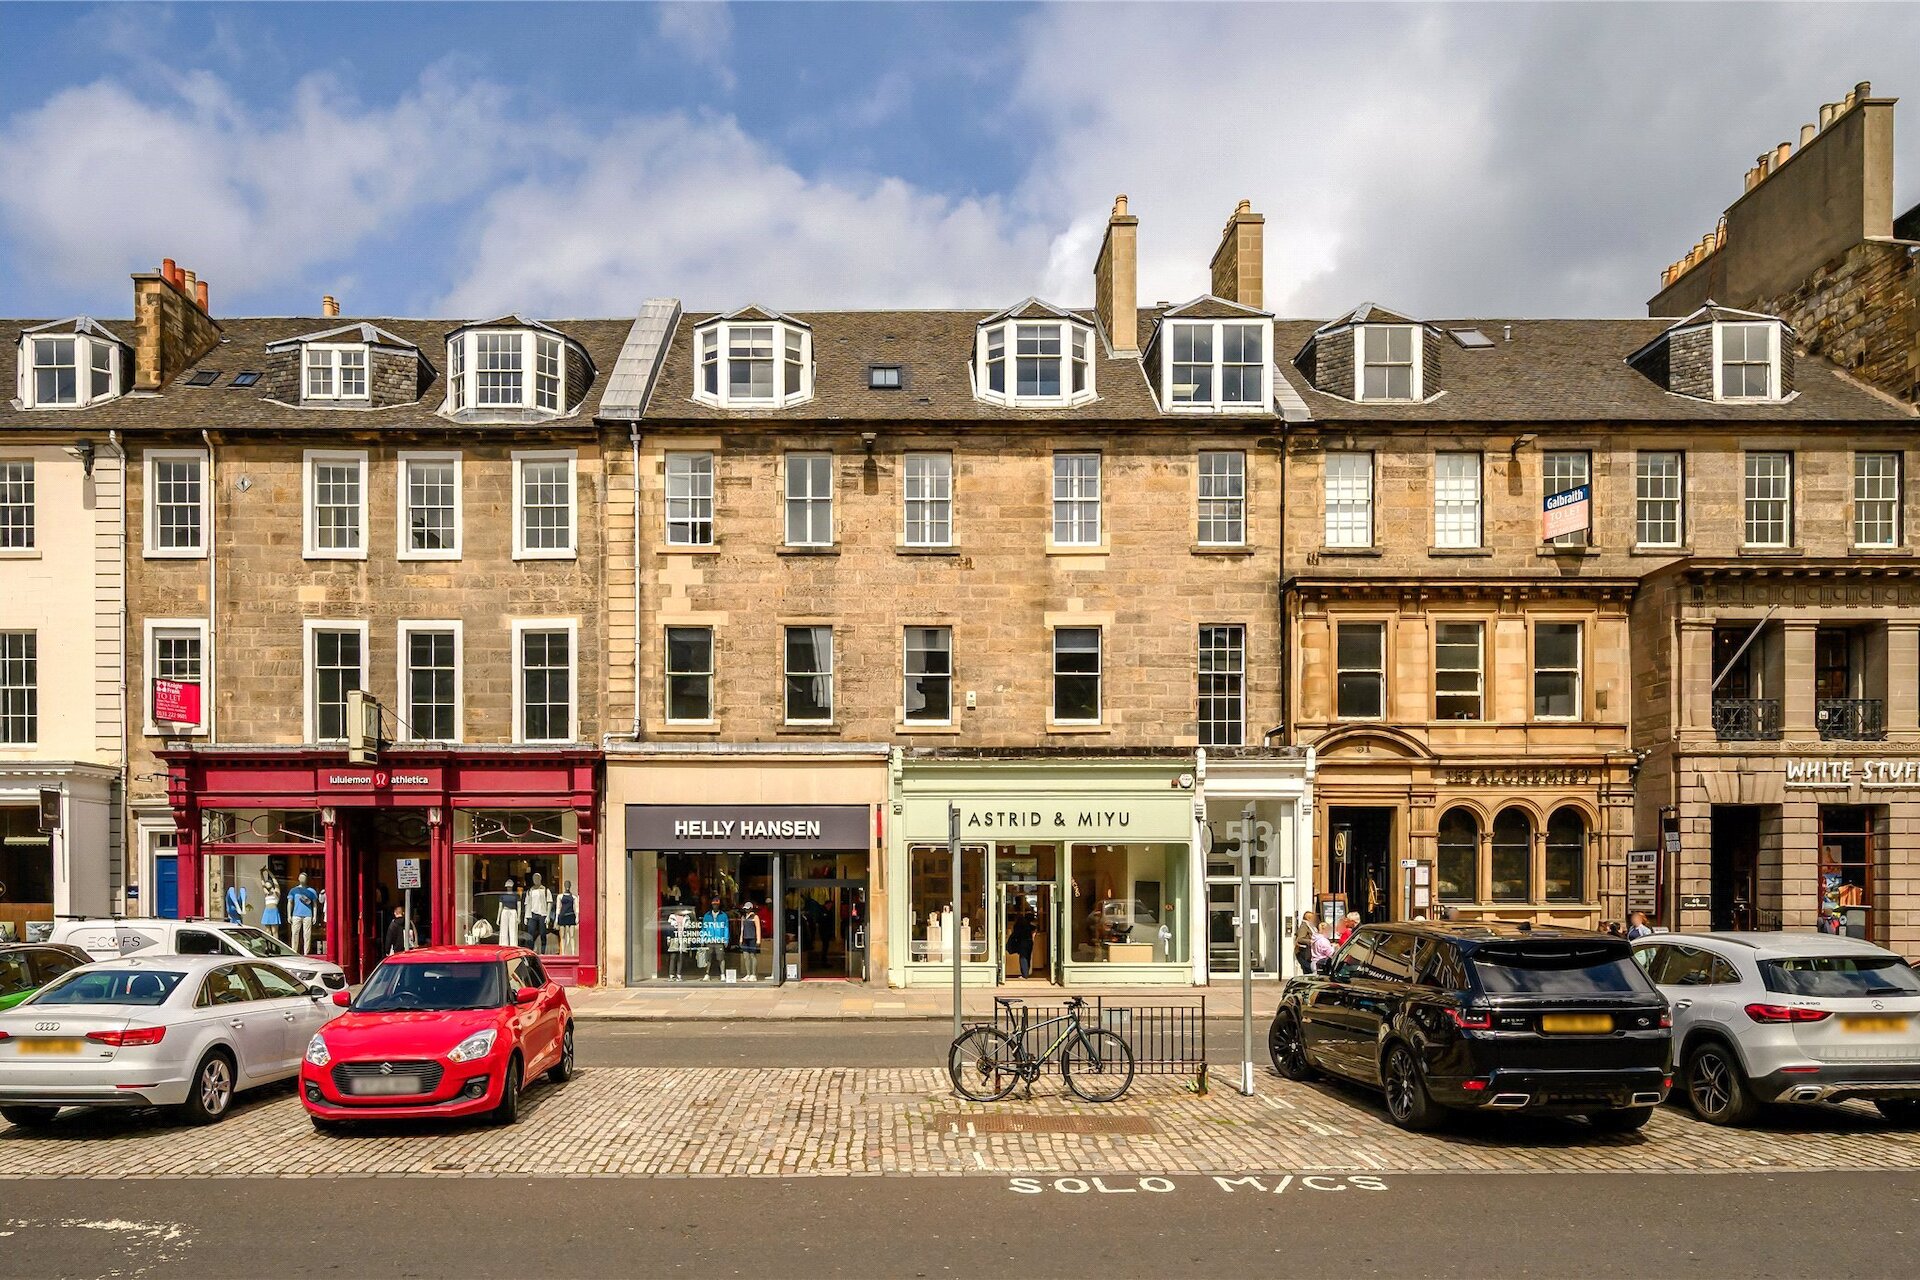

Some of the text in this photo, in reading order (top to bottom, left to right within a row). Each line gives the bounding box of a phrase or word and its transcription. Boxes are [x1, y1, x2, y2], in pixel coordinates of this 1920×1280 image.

[1547, 489, 1583, 509] Galbraith
[156, 692, 168, 700] TO
[170, 694, 181, 702] LET
[1787, 760, 1920, 780] WHITE STUF
[330, 776, 429, 784] lululemon athletica
[968, 812, 1129, 827] ASTRID & MIYU
[675, 820, 820, 837] HELLY HANSEN
[1008, 1175, 1389, 1194] SOLO M/CS
